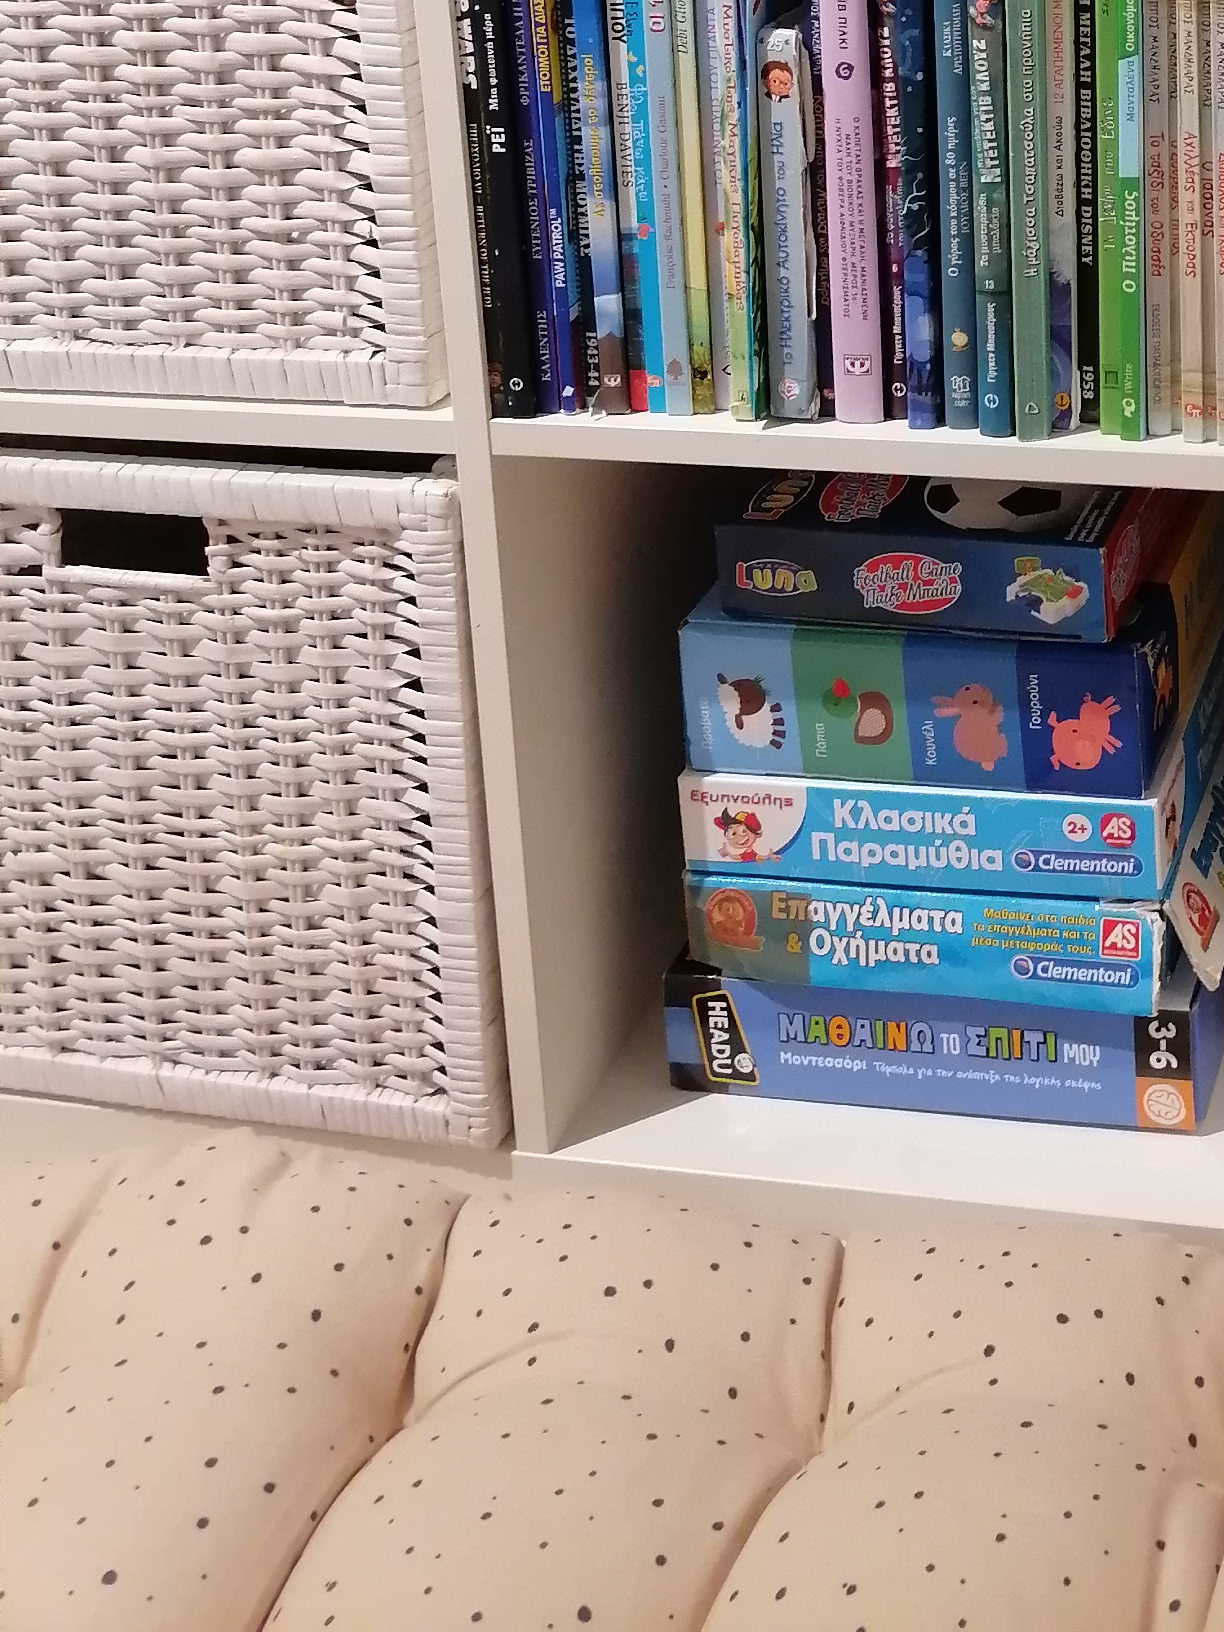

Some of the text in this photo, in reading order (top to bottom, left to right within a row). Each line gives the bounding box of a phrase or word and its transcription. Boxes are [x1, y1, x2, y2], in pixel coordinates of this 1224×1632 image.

[483, 13, 494, 38] μέρα
[973, 39, 991, 91] ΚΛΟΥΖ
[1079, 12, 1092, 83] ΜΕΓΑΛΗ
[488, 88, 499, 110] Μια
[616, 82, 628, 127] BENJI
[1052, 116, 1064, 151] Ακούω
[1080, 89, 1092, 200] ΒΙΒΛΙΟΘΗΚΗ
[619, 133, 633, 188] DAVIES
[945, 152, 955, 165] 80
[1055, 154, 1063, 170] και
[1081, 206, 1093, 265] DISNEY
[950, 268, 958, 276] Ο
[1124, 280, 1136, 293] Ο
[1083, 366, 1095, 399] 1958
[736, 561, 818, 593] Luna
[854, 559, 962, 588] Football Game
[1028, 674, 1042, 729] Γουρούνι
[923, 720, 937, 766] Κουνέλι
[834, 798, 976, 836] Κλασικά
[1066, 820, 1088, 837] 2+
[1102, 814, 1133, 841] AS
[811, 832, 1003, 872] Παραμύθια
[1038, 853, 1137, 875] Clementoni
[770, 891, 963, 935] Επαγγέλματα
[786, 926, 940, 968] & Οχήματα
[1104, 923, 1138, 950] AS
[1036, 961, 1132, 985] Clementoni
[705, 1000, 735, 1075] HEADU
[777, 1013, 934, 1054] ΜΑΘΑΙΝΩ
[940, 1033, 960, 1055] ΤΟ
[966, 1026, 1058, 1064] ΣΠΙΤΙ
[1147, 1020, 1179, 1071] 3-6
